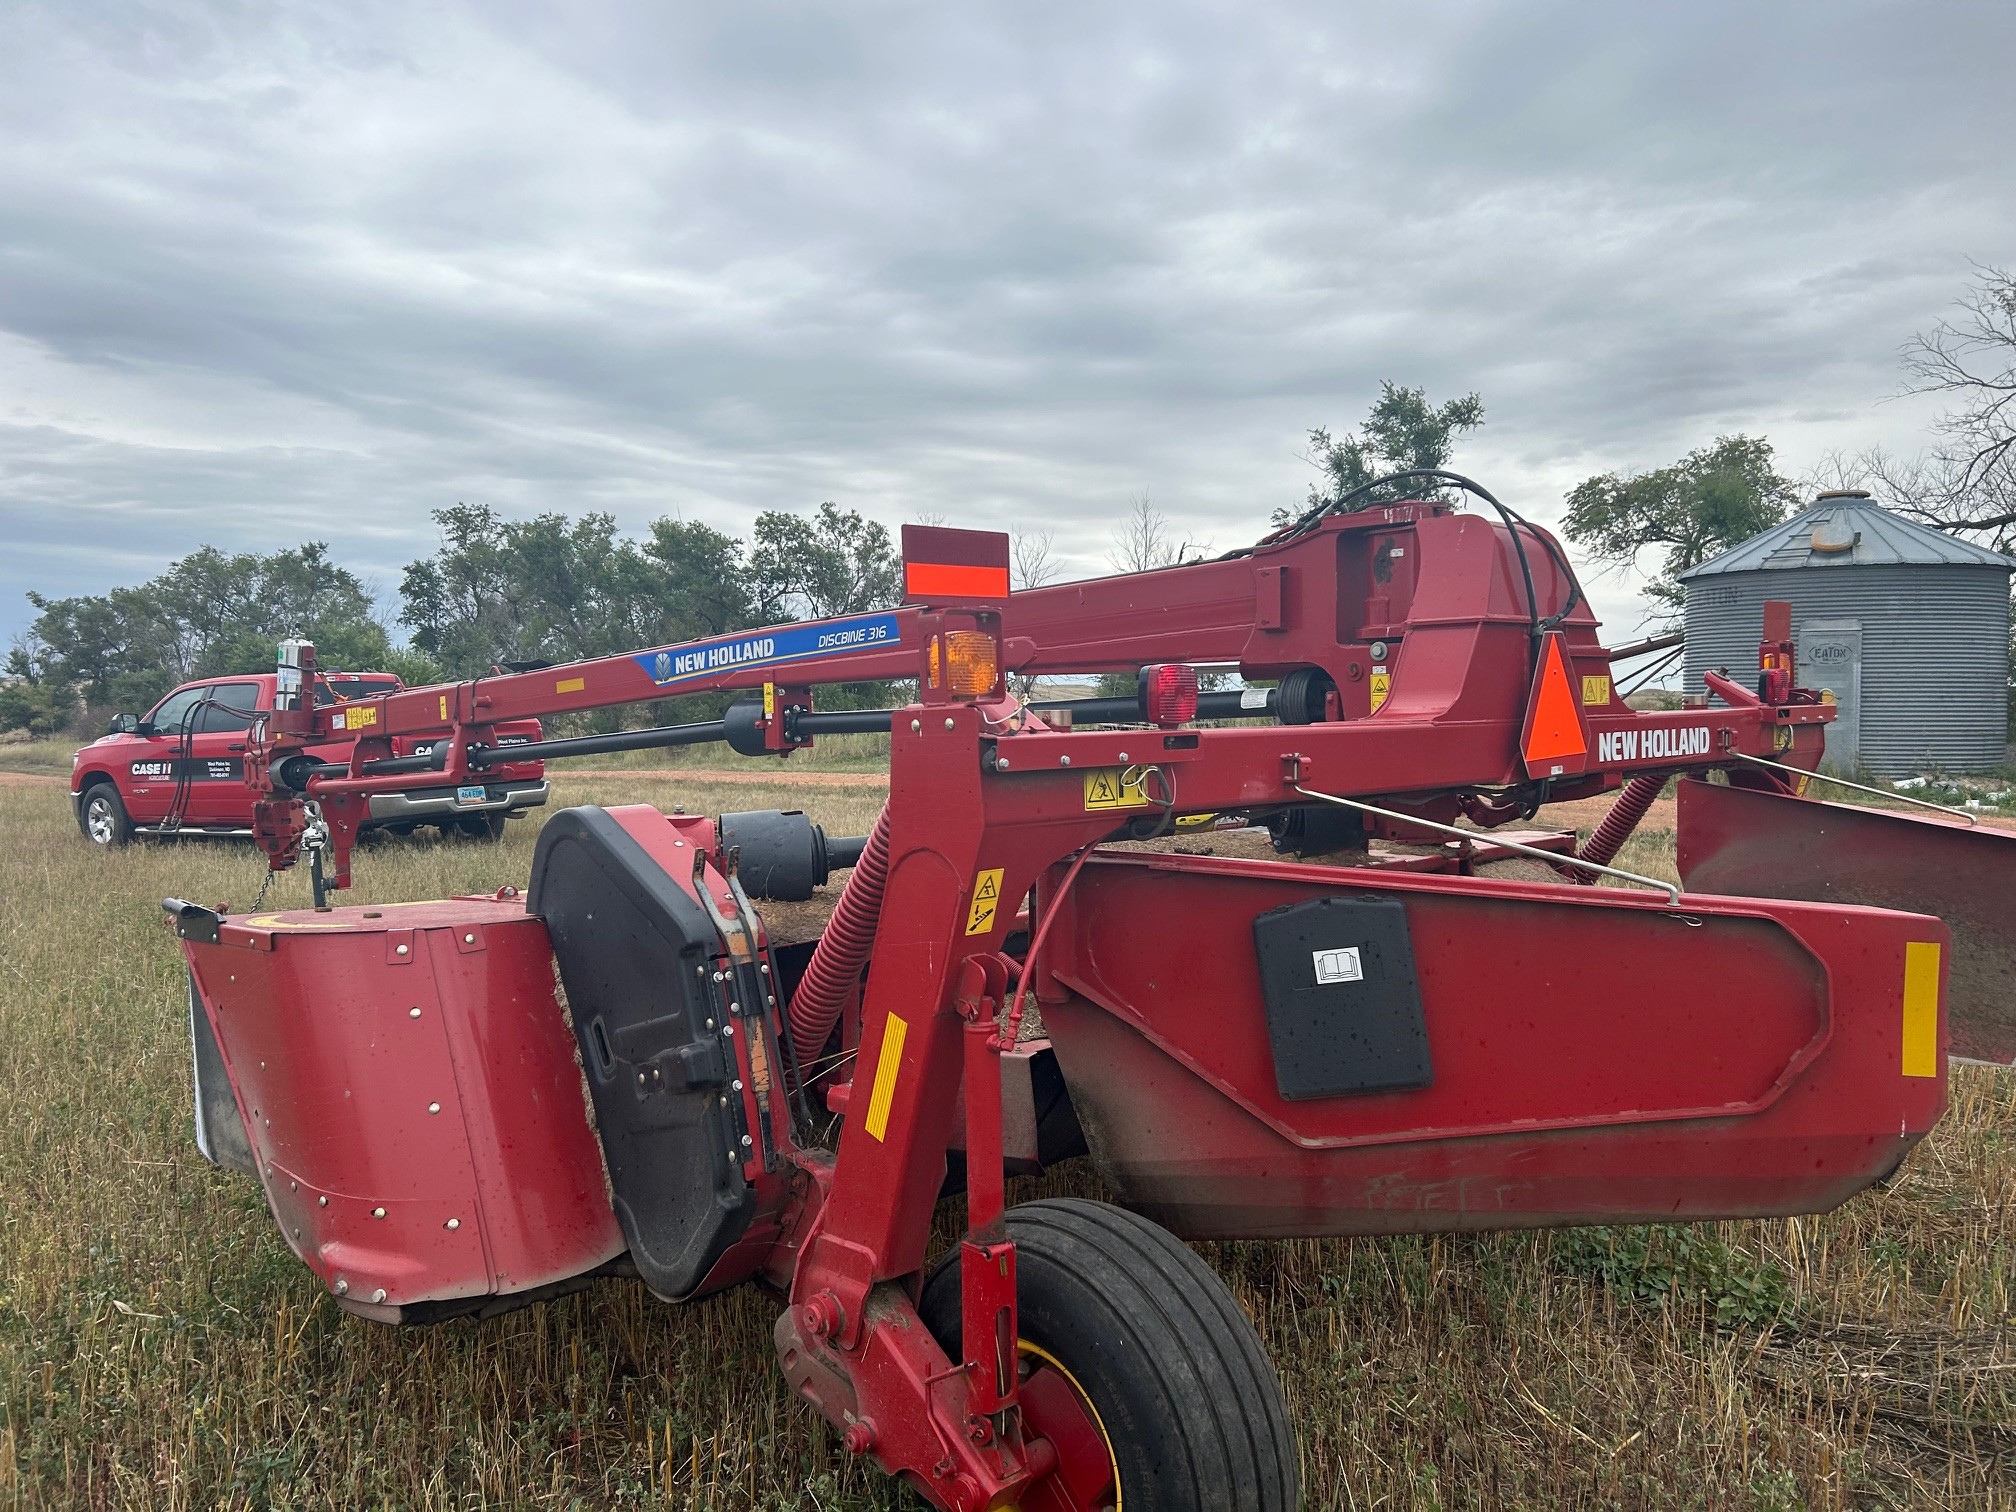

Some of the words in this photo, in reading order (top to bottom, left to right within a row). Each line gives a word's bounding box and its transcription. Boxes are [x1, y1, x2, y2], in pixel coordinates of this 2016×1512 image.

[818, 628, 866, 649] DISCBINE
[867, 625, 887, 640] 316
[675, 654, 705, 675] NEW
[708, 638, 775, 668] HOLLAND
[1814, 647, 1846, 659] EATON
[1598, 731, 1638, 762] NEW
[1640, 727, 1710, 758] HOLLAND
[131, 763, 161, 775] CASE
